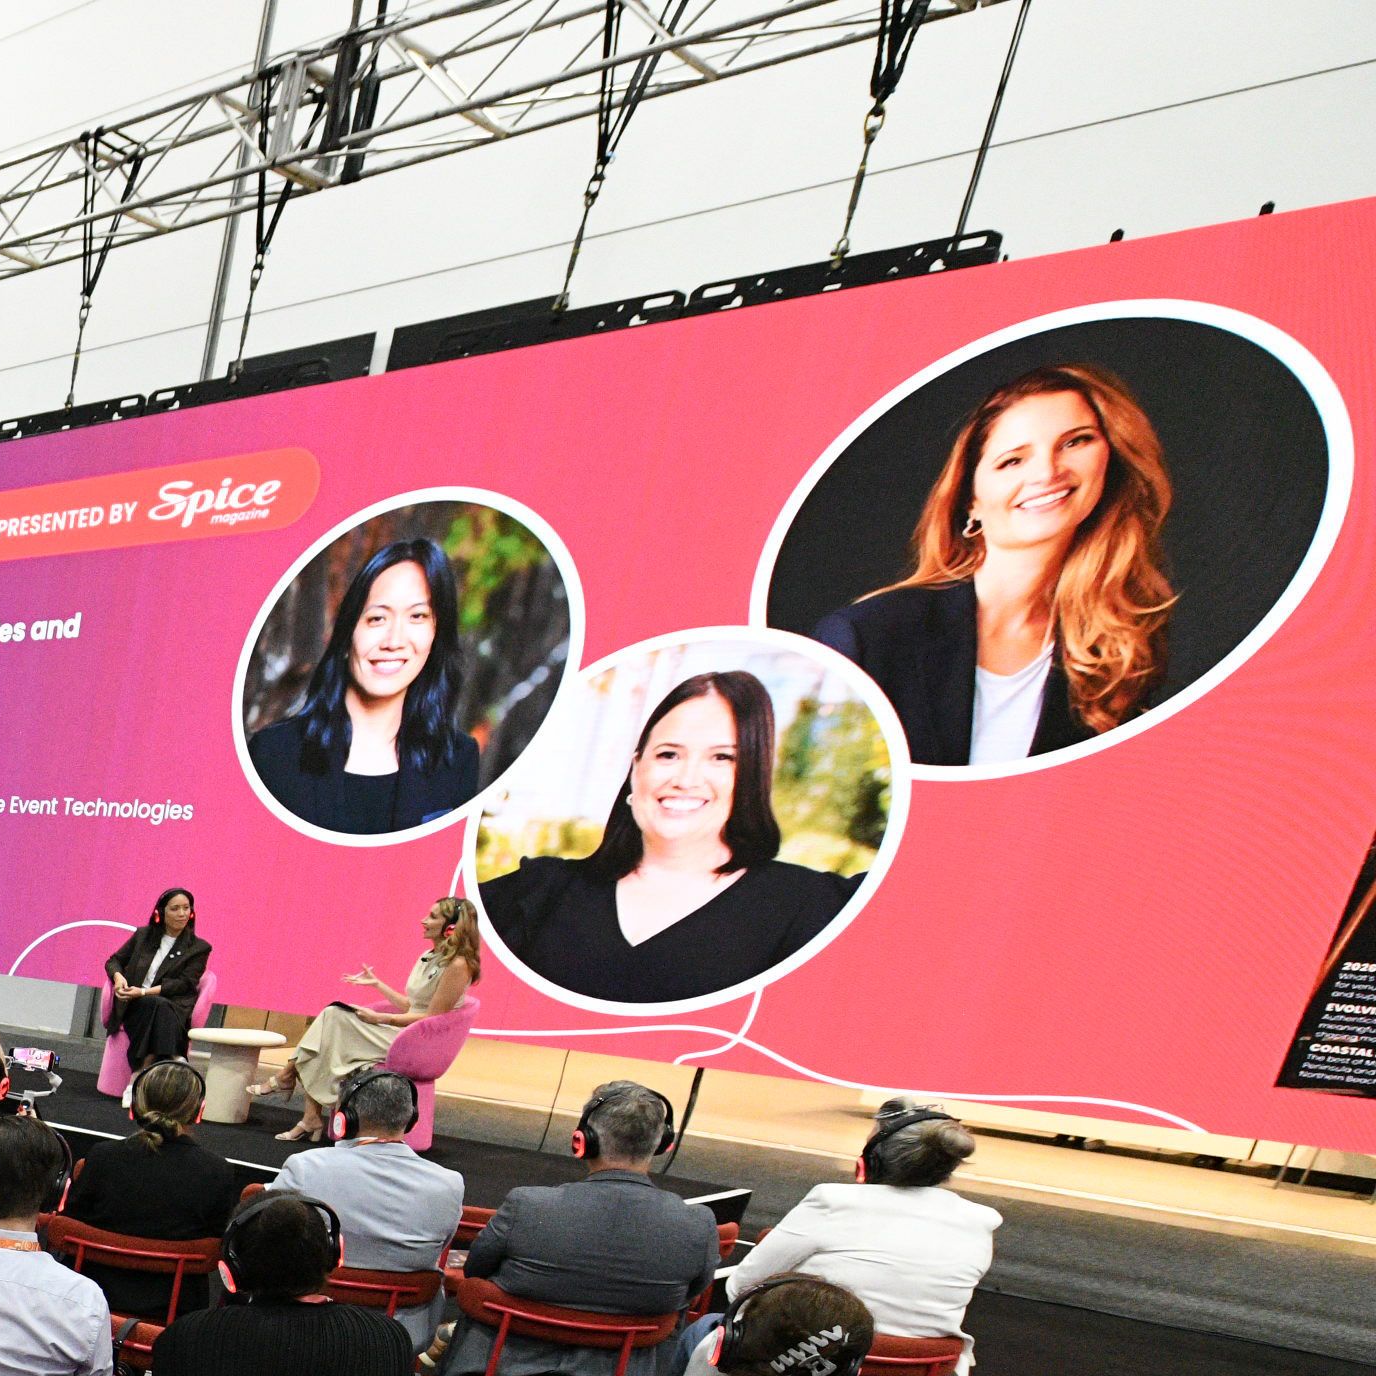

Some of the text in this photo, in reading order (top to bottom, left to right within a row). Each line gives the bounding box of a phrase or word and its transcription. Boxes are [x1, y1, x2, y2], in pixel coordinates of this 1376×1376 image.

[108, 501, 138, 524] BY
[148, 477, 281, 528] Spice
[209, 507, 269, 526] magazine
[30, 612, 82, 641] and
[9, 795, 58, 816] Event
[64, 797, 194, 826] Technologies
[1309, 1043, 1373, 1057] COASTAL
